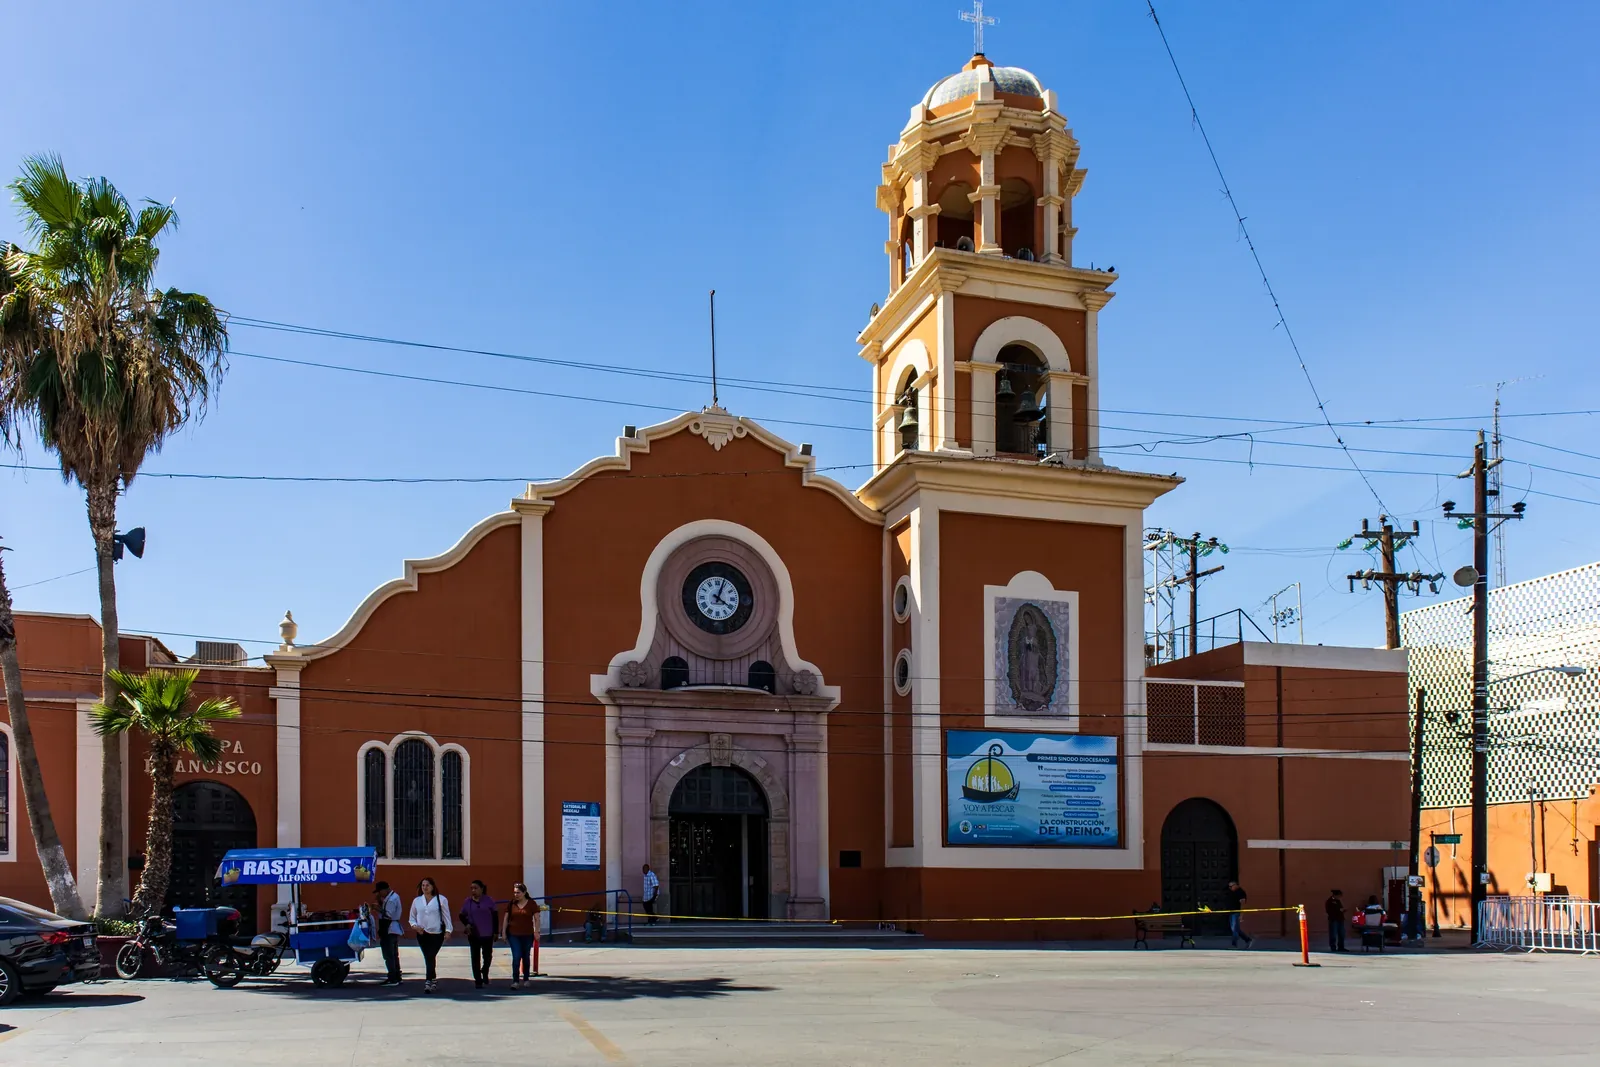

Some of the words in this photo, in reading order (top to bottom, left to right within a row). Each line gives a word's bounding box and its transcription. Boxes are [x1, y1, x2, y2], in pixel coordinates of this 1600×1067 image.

[144, 758, 262, 775] FANCISCO
[963, 804, 980, 812] VOY
[987, 805, 1015, 813] PESCAR
[1050, 818, 1104, 826] CONSTRUCCIÓN
[1039, 826, 1062, 835] DEL
[242, 858, 352, 875] RASPADOS
[277, 874, 318, 882] ALFONSO
